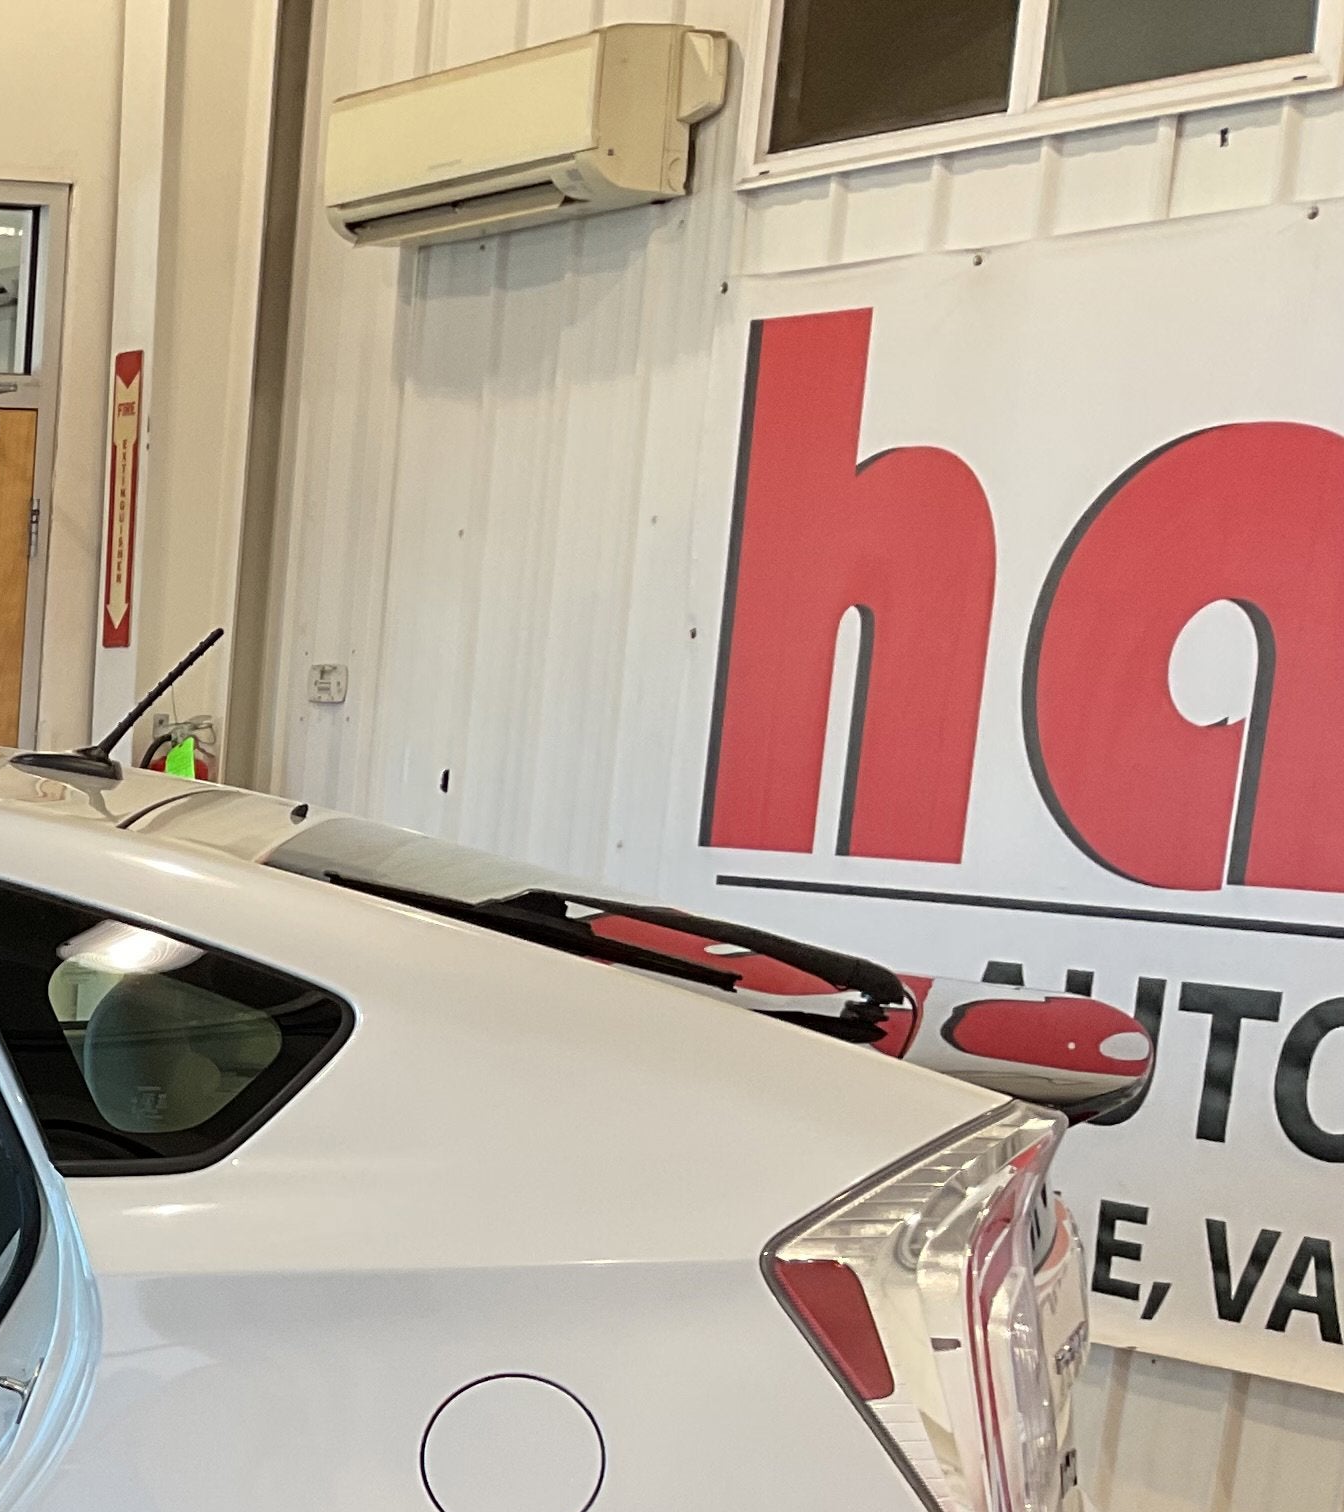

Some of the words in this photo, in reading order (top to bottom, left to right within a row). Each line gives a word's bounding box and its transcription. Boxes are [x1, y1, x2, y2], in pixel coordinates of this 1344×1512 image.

[117, 401, 136, 417] FIRE
[115, 439, 128, 584] EXTINGUISHER
[1205, 1218, 1344, 1345] VA
